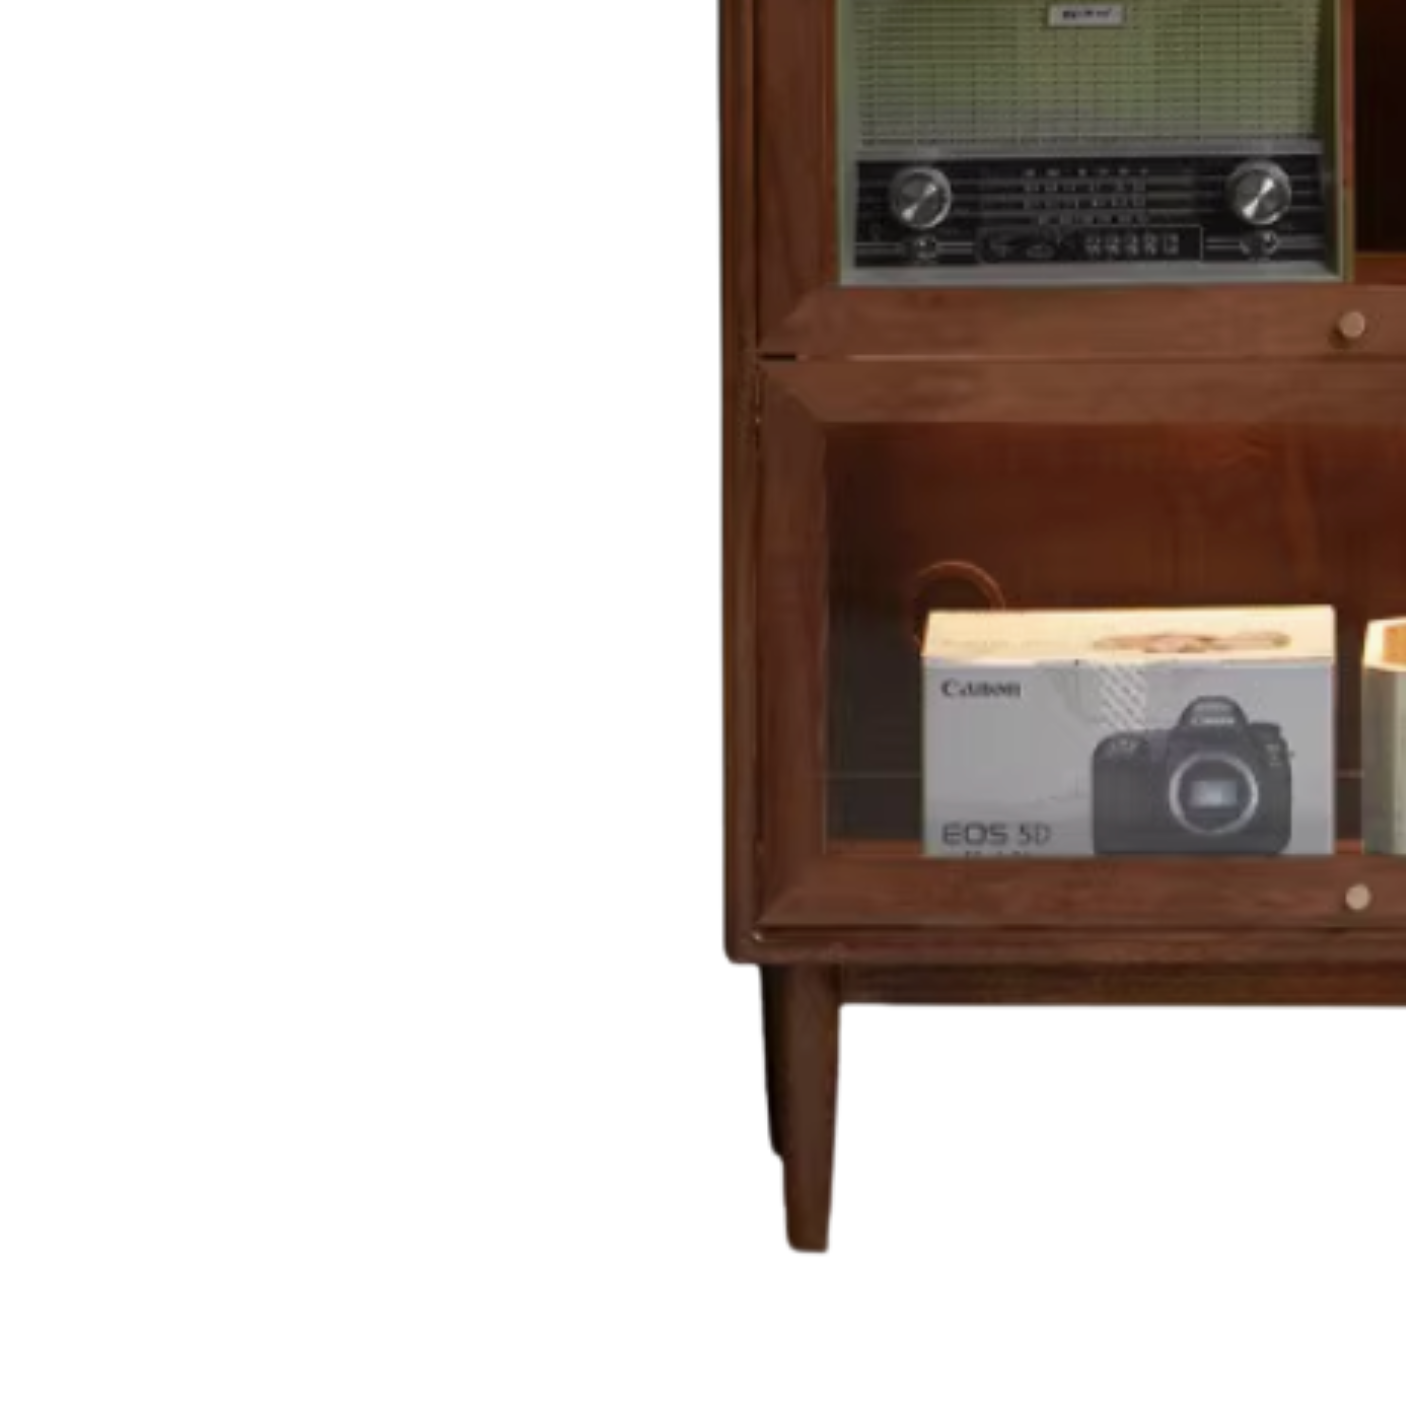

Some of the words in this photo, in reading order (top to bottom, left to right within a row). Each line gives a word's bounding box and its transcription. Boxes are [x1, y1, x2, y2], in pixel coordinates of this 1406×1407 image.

[940, 678, 1021, 699] Canon
[942, 821, 1009, 846] EOS
[1018, 821, 1052, 846] 5D
